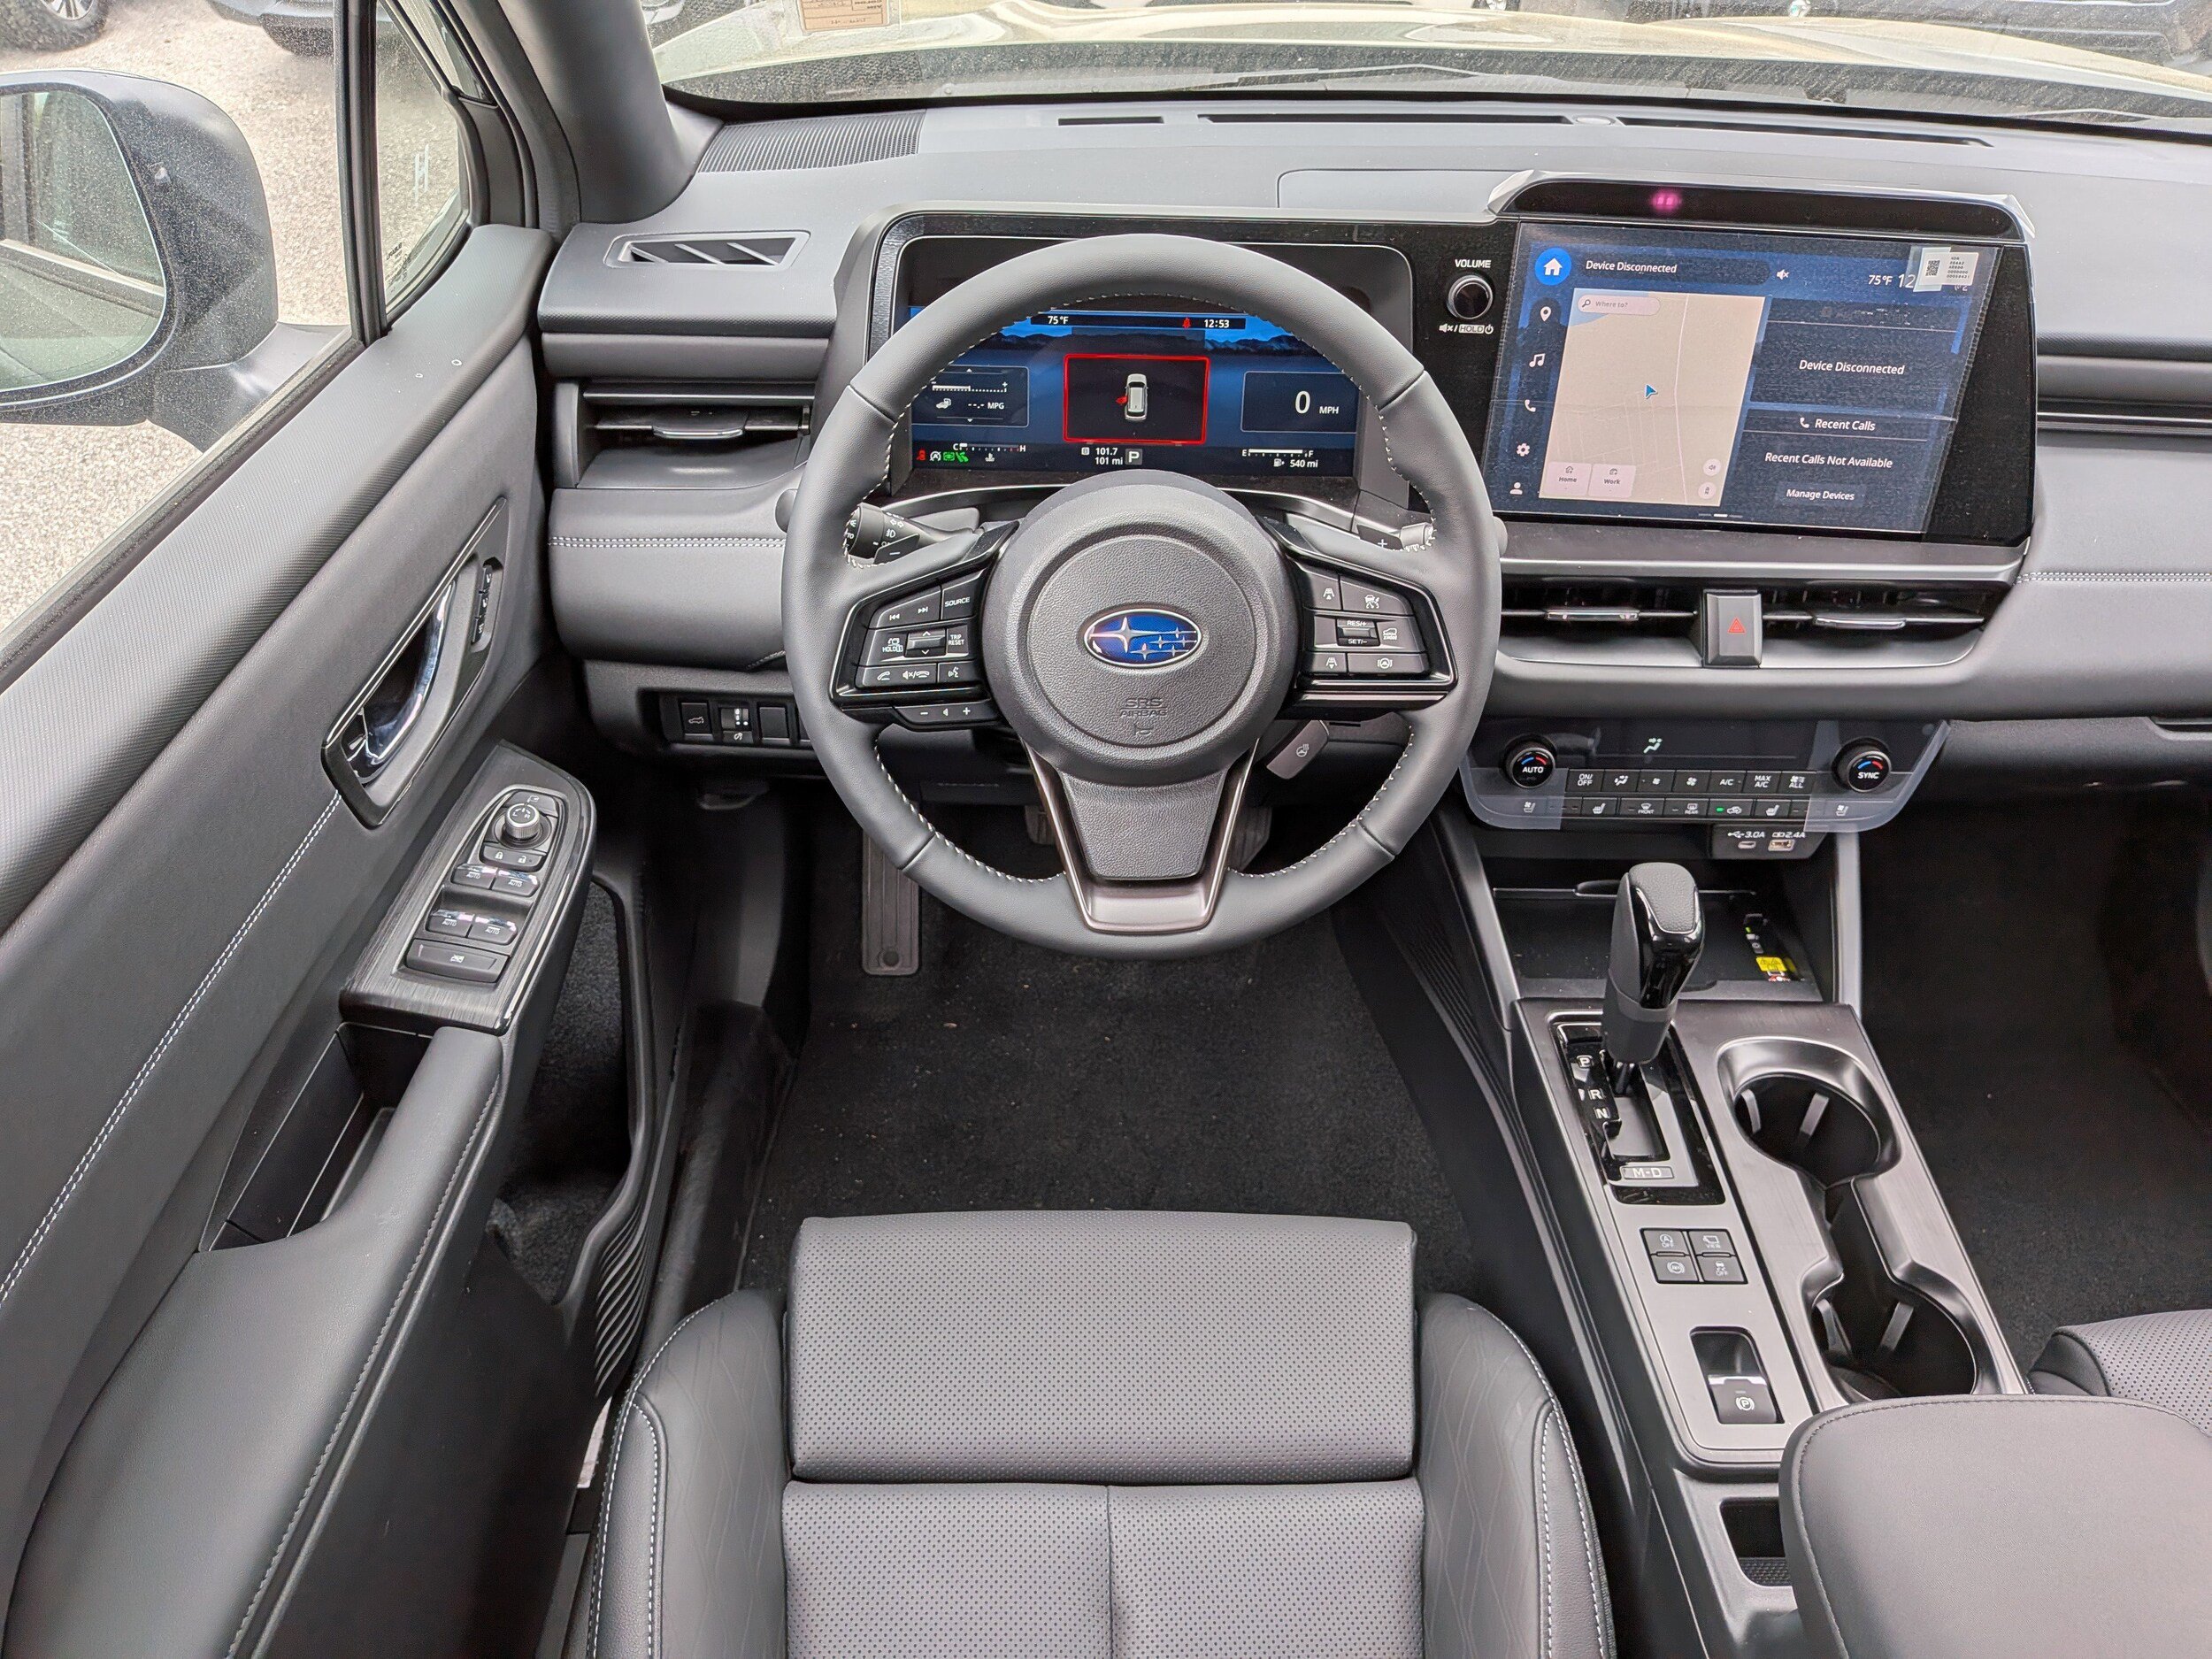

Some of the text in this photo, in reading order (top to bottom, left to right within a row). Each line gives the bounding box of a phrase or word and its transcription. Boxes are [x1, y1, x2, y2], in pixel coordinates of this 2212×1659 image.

[1455, 259, 1492, 268] VOLUME
[1586, 260, 1678, 273] Device Disconnected
[1868, 274, 1893, 286] 75°F
[1047, 316, 1069, 325] 75°F
[1203, 319, 1231, 328] 12:53
[1458, 324, 1485, 334] HOLD
[1799, 359, 1905, 374] Device Disconnected
[1294, 390, 1311, 414] 0
[1815, 419, 1876, 431] Recent Calls
[1095, 447, 1118, 456] 101.7
[1094, 457, 1124, 465] 101 mi
[1128, 451, 1140, 463] P
[1764, 452, 1893, 468] Recent Calls Not Available
[1289, 459, 1306, 468] 540
[1786, 488, 1855, 500] Manage Devices
[944, 596, 971, 608] SOURCE
[1125, 697, 1164, 709] SRS
[1119, 709, 1168, 718] AIRBAG
[1578, 1057, 1591, 1066] P
[1591, 1090, 1602, 1100] R
[1596, 1109, 1608, 1118] N
